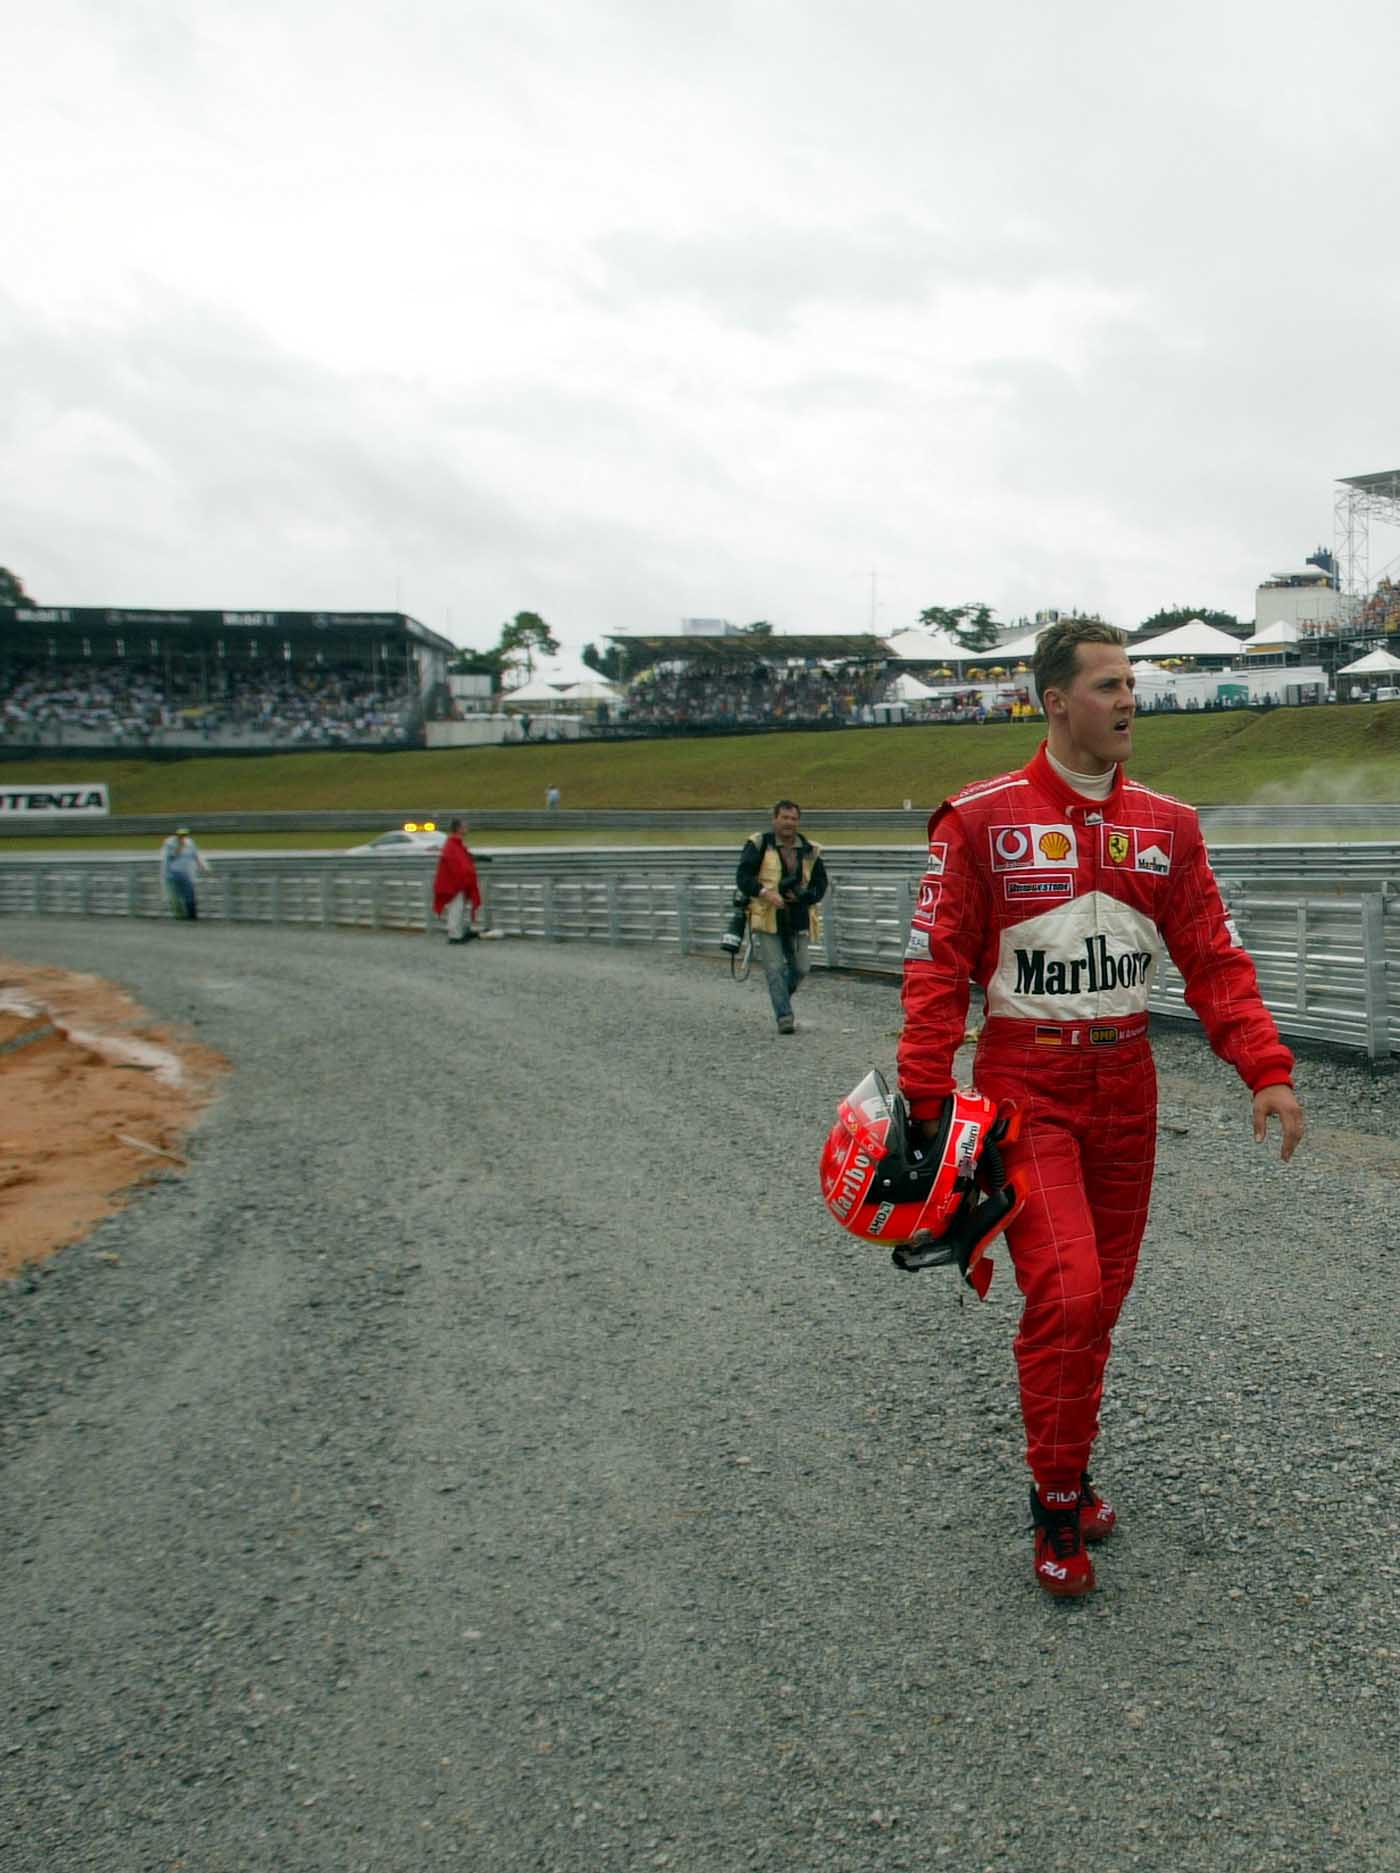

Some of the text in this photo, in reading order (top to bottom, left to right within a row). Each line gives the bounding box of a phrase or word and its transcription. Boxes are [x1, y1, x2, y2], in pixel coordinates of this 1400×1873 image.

[0, 793, 103, 809] TENZA
[1014, 935, 1152, 995] Marlboro
[1046, 1491, 1078, 1503] FILA
[1039, 1561, 1068, 1580] FILA
